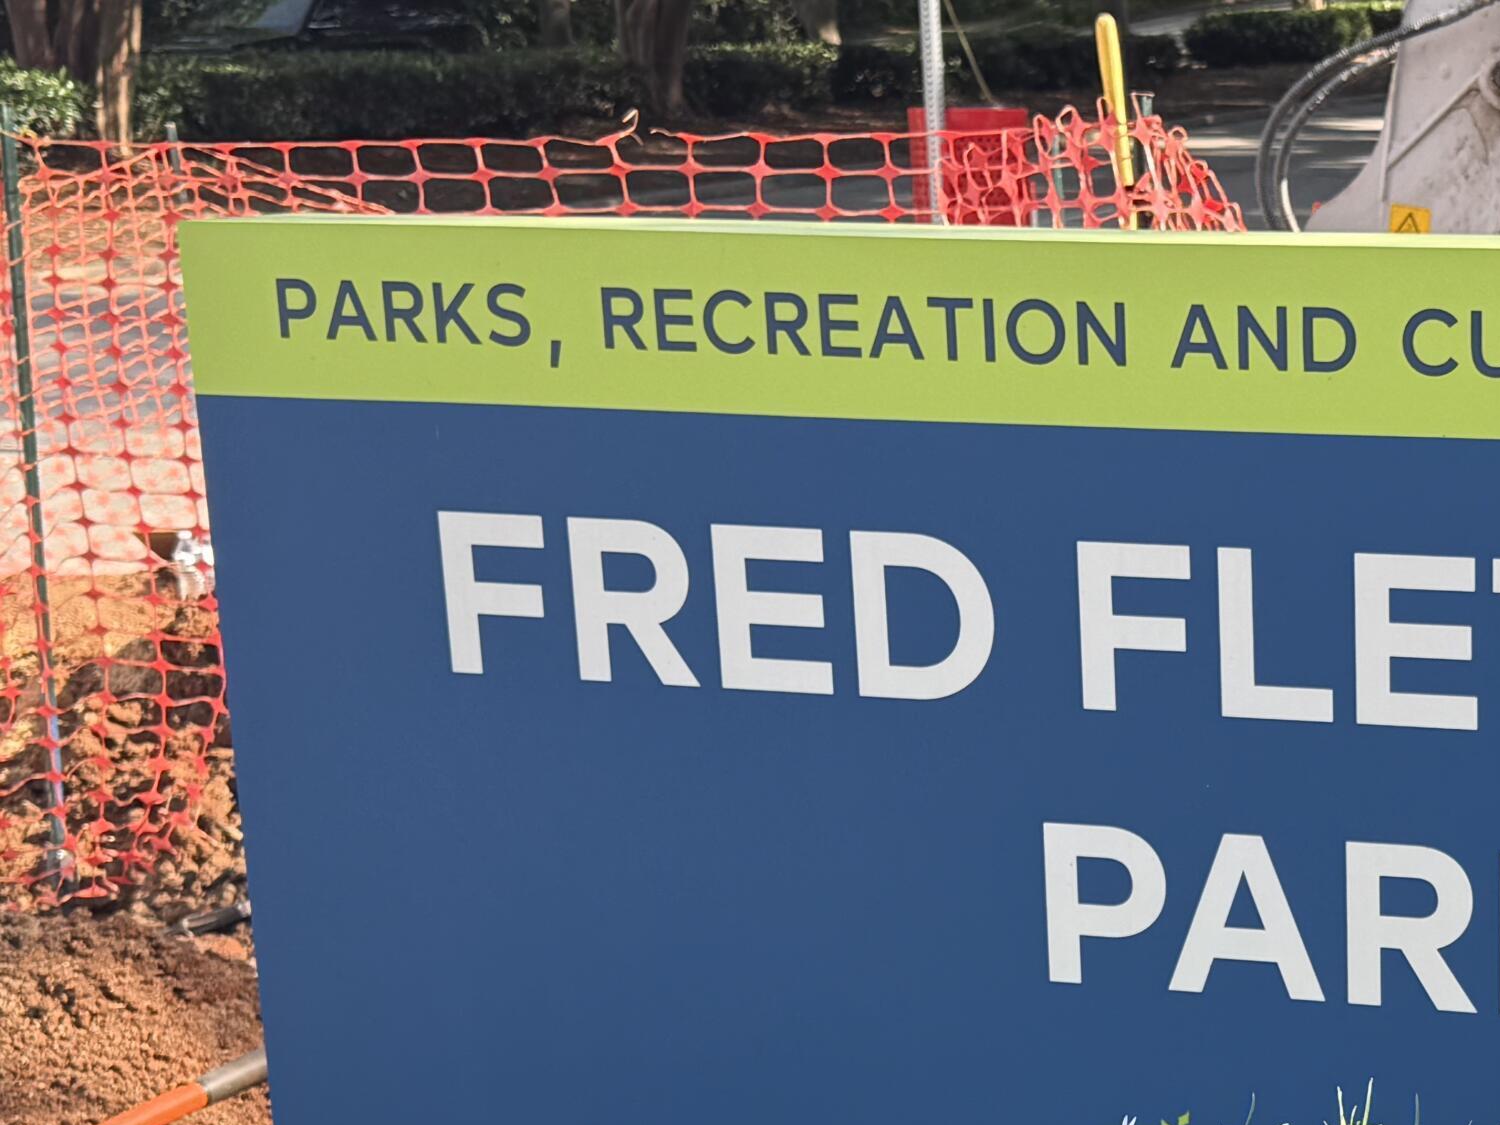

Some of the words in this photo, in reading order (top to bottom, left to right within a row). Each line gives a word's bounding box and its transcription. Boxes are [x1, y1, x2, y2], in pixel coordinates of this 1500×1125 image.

[275, 277, 562, 369] PARKS,
[600, 286, 1127, 367] RECREATION
[1170, 303, 1357, 374] AND
[436, 509, 996, 701] FRED
